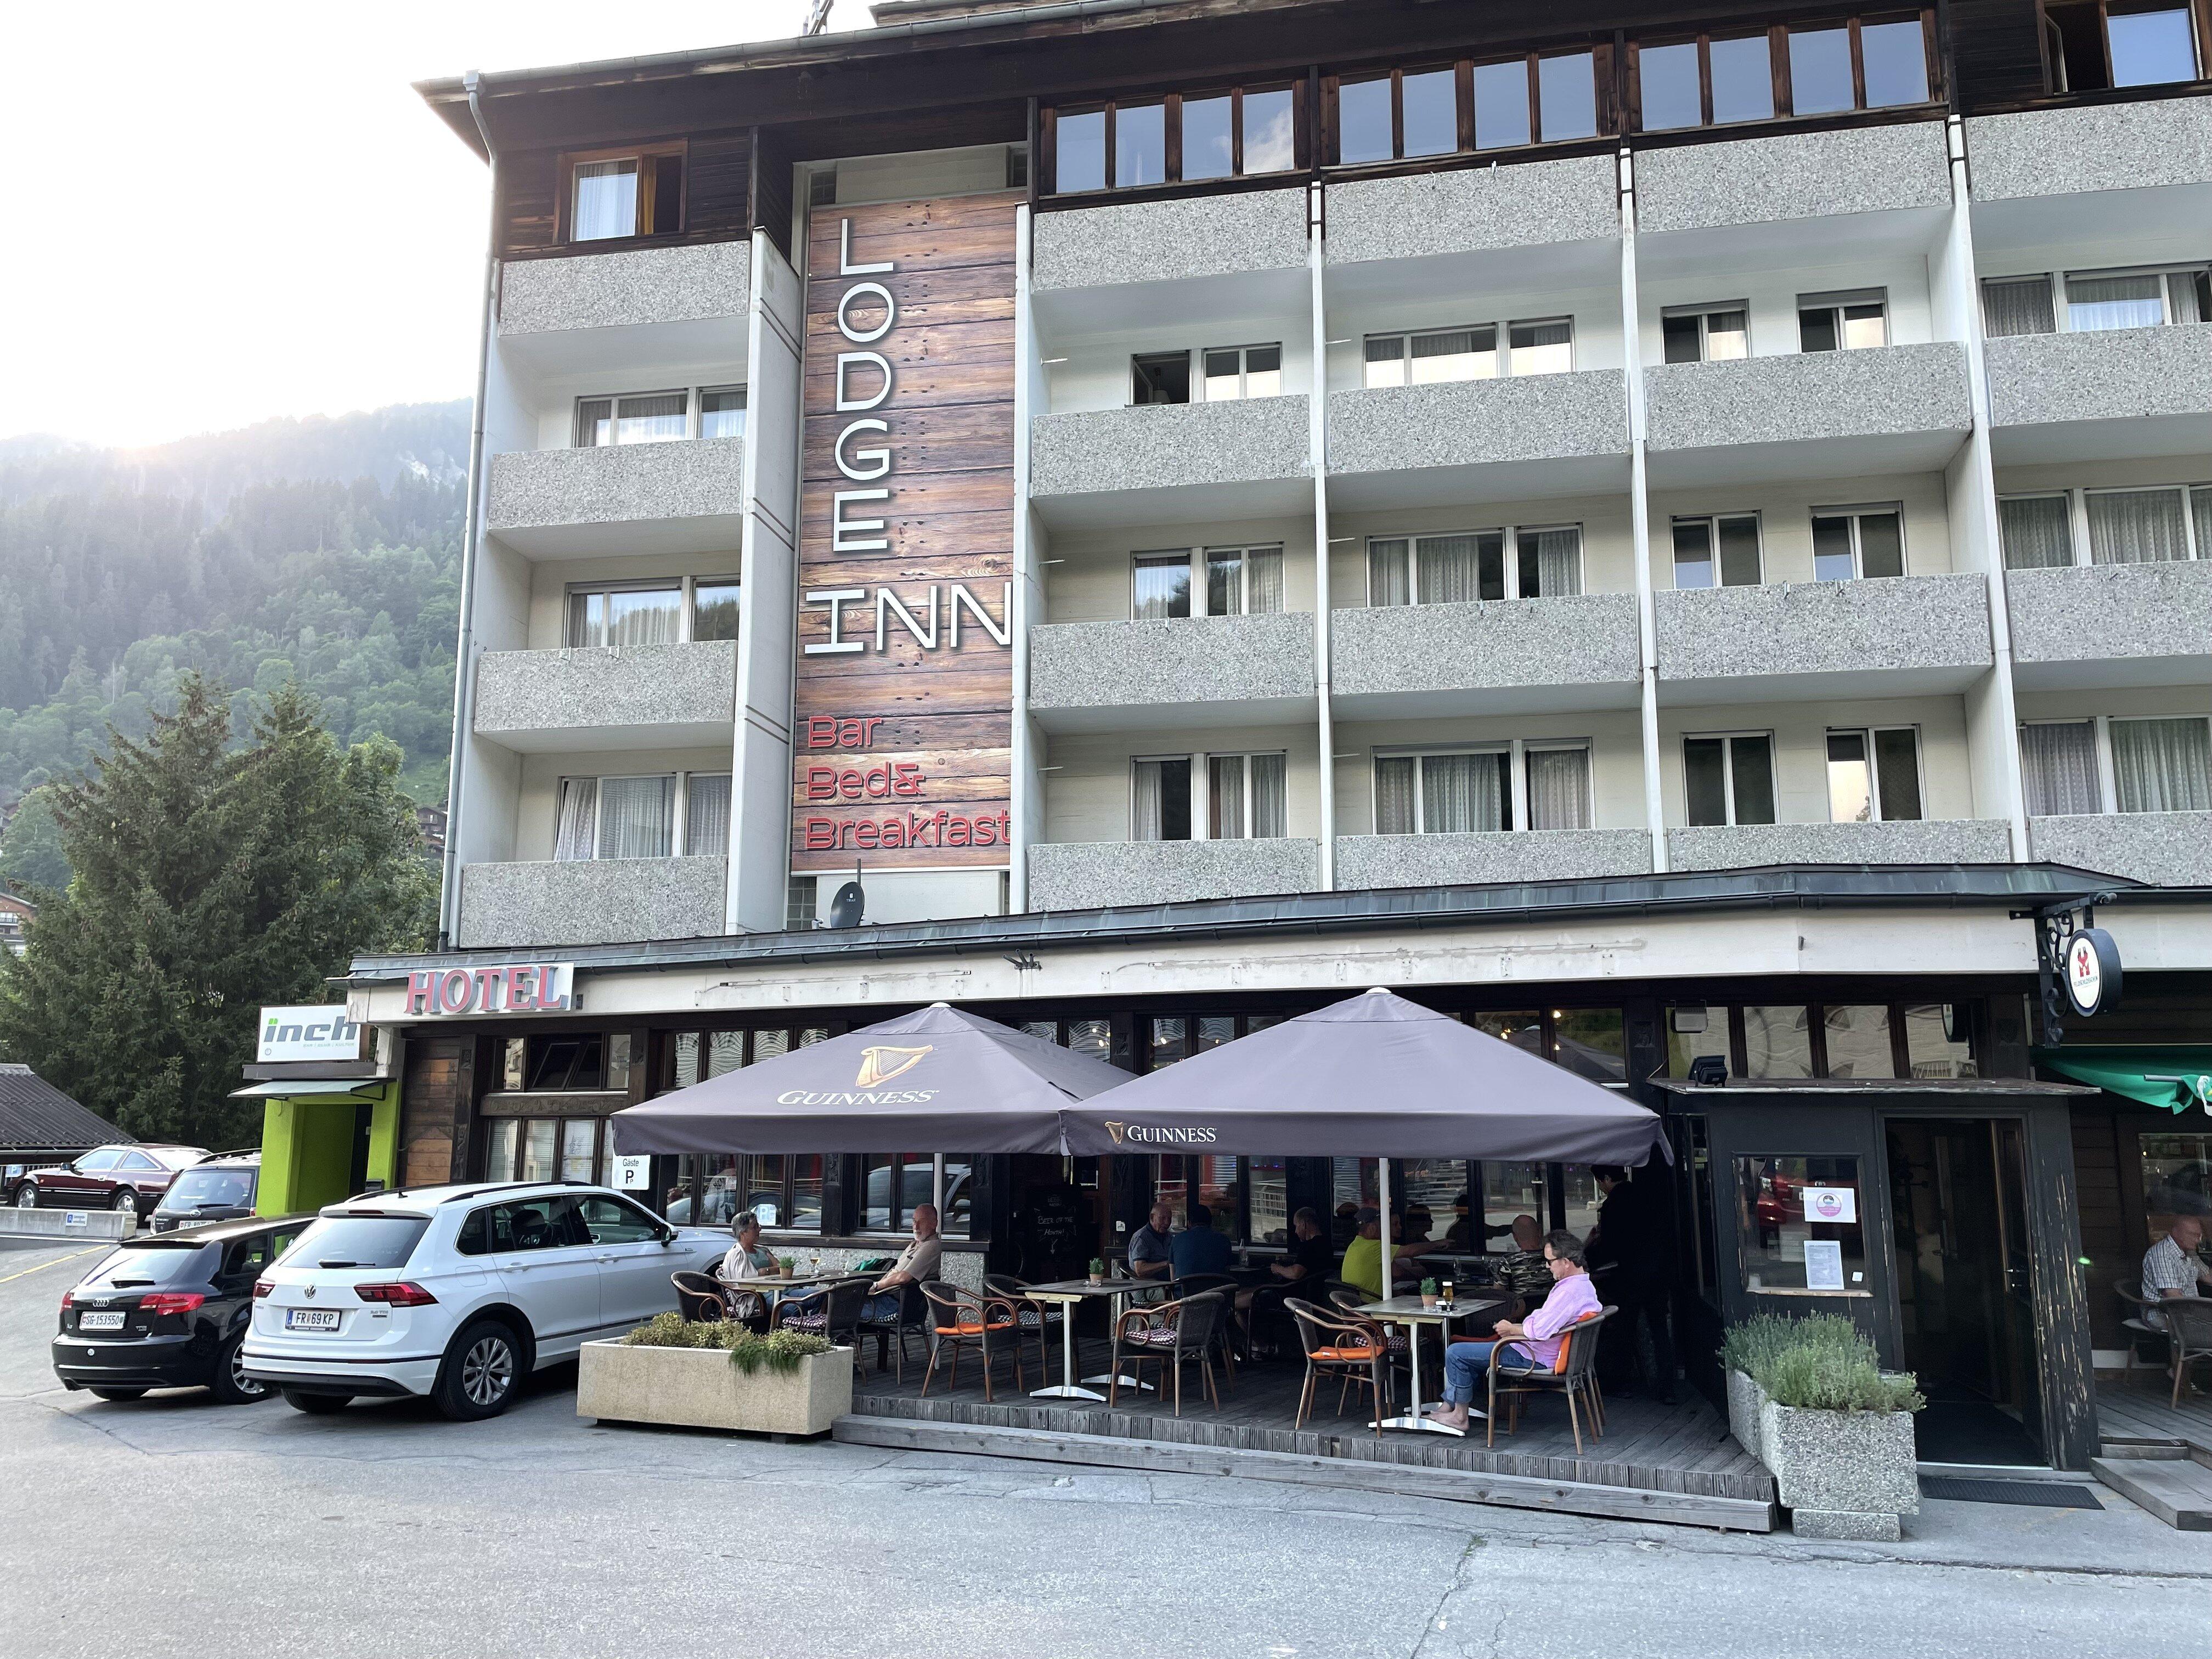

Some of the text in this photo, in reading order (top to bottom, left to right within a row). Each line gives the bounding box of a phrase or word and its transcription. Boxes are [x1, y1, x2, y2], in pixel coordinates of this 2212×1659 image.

[833, 218, 895, 552] LODGE
[804, 582, 1012, 654] INN
[808, 715, 883, 748] Bar
[807, 762, 926, 799] Bed&
[805, 809, 1011, 849] Breakfast
[404, 966, 569, 1015] HOTEL
[264, 1017, 357, 1042] inch
[777, 1090, 937, 1105] GUINNESS
[1127, 1125, 1217, 1143] GUINNESS
[623, 1158, 639, 1167] Gäste
[625, 1170, 634, 1184] P
[296, 1312, 334, 1325] FR 69 KP
